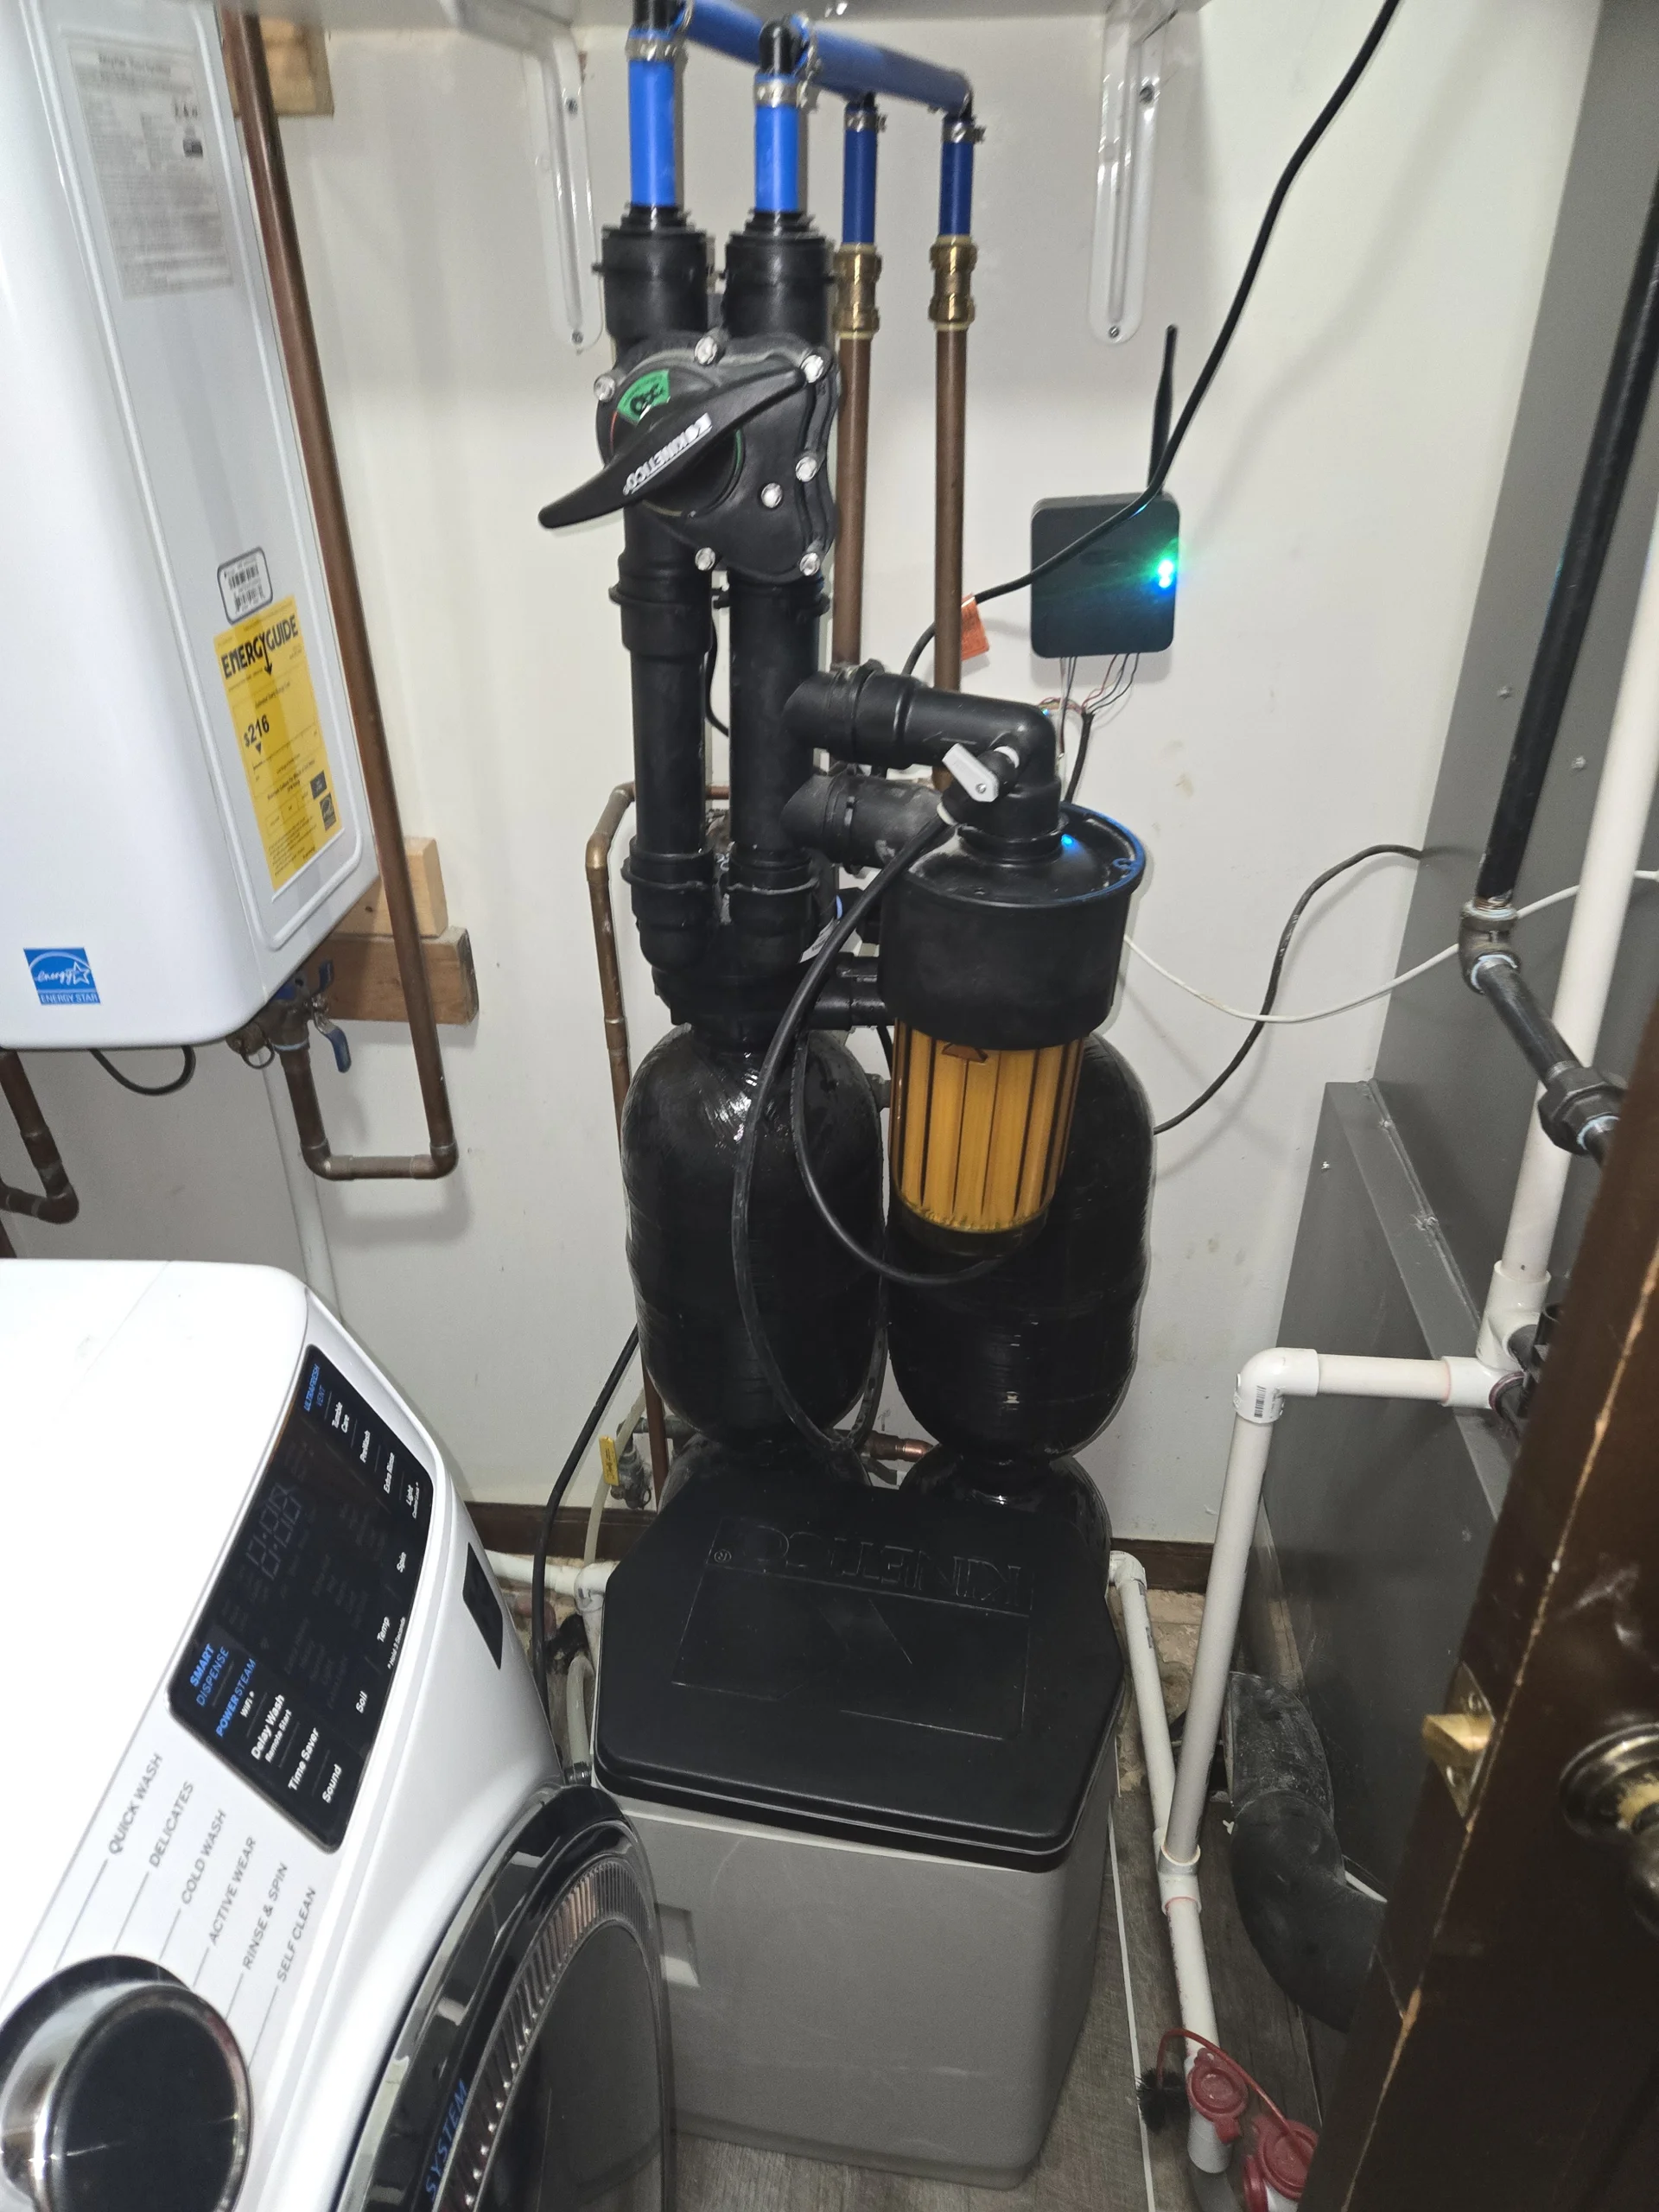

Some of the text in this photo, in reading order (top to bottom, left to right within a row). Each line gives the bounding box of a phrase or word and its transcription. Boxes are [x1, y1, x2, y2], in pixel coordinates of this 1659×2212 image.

[221, 614, 298, 679] ENERGYGUIDE
[244, 714, 270, 747] $216
[40, 993, 98, 1003] ENERGY STAR
[383, 1471, 392, 1494] Extra
[377, 1617, 391, 1643] Temp
[190, 1643, 214, 1687] SMART
[196, 1646, 229, 1707] DISPENSE
[251, 1694, 285, 1760] Delay Wash
[356, 1690, 368, 1713] Soil
[264, 1709, 292, 1763] Remote Start
[288, 1727, 319, 1790] Time Saver
[108, 1752, 163, 1854] QUICK WASH
[321, 1764, 342, 1803] Sound
[149, 1781, 194, 1868] DELICATES
[181, 1808, 226, 1904] COLD WASH
[208, 1836, 257, 1946] ACTIVE WEAR
[242, 1863, 288, 1970] RINSE & SPIN
[277, 1887, 316, 1982] SELF CLEAN
[425, 2078, 467, 2202] SYSTEM
